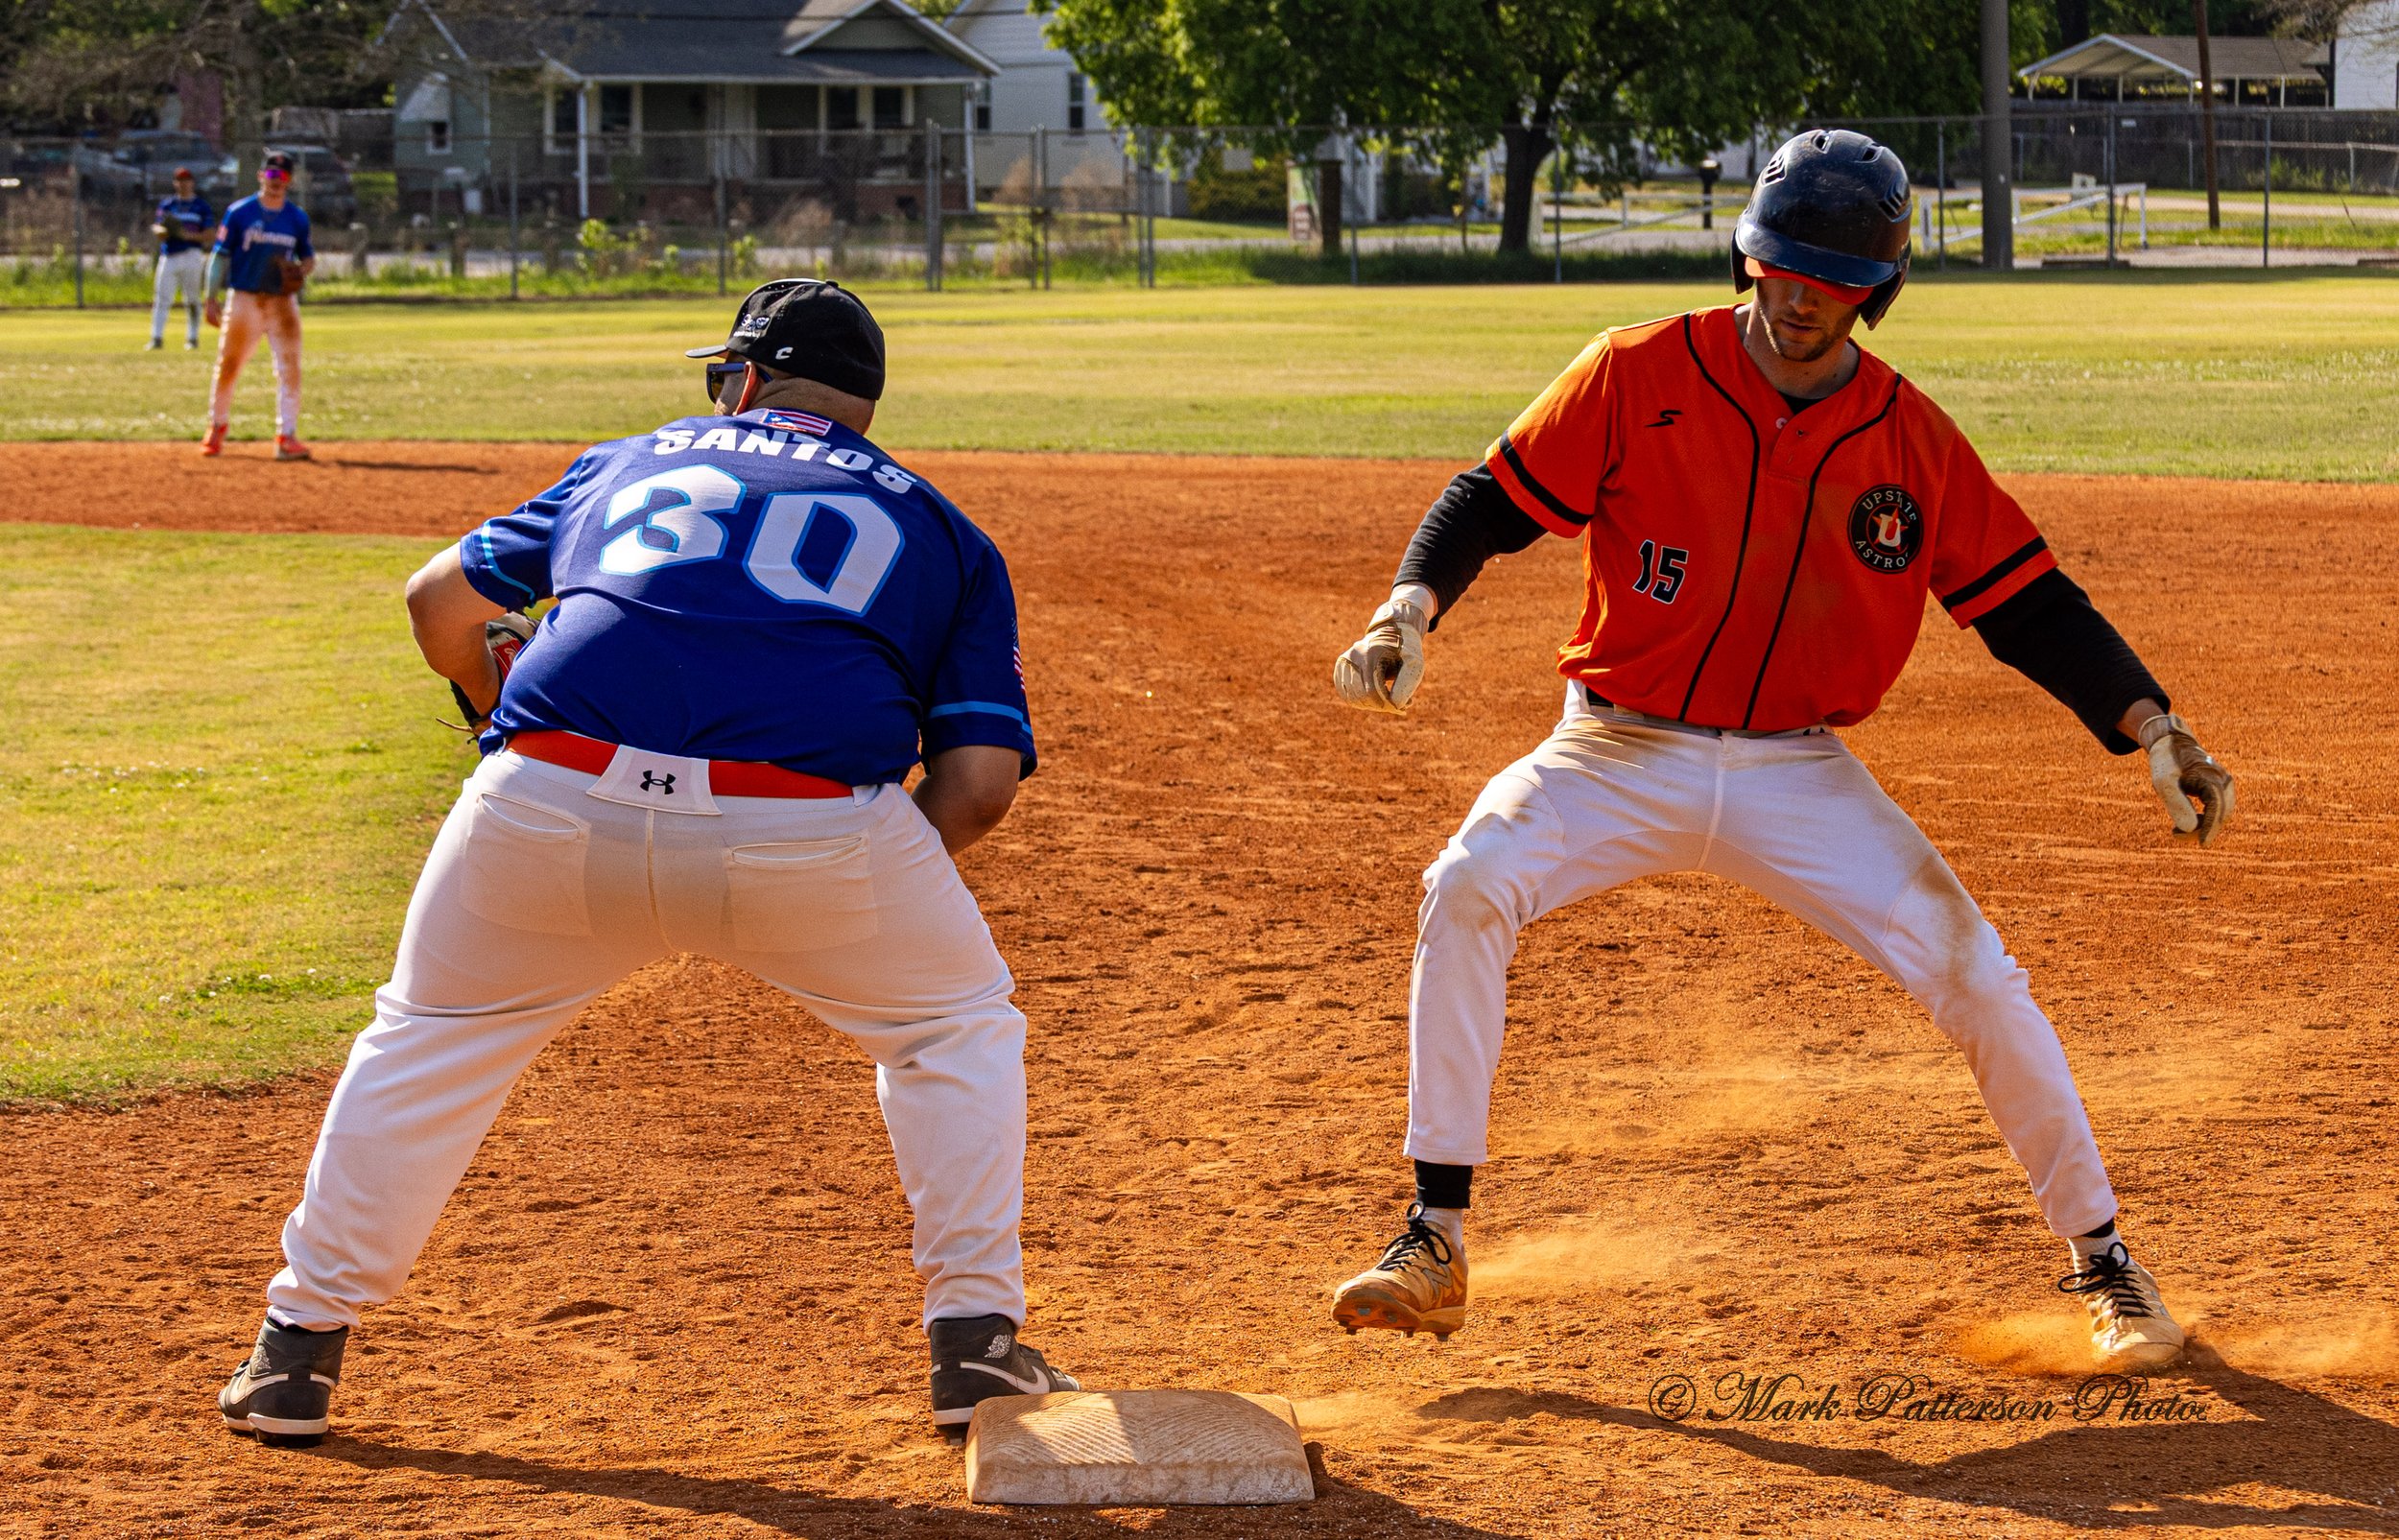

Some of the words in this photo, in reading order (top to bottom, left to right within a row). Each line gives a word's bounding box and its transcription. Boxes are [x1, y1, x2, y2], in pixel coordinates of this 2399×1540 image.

[653, 428, 917, 494] SANTOS
[599, 463, 906, 617] 30
[1632, 539, 1689, 604] 15
[1855, 539, 1909, 568] ASTRO
